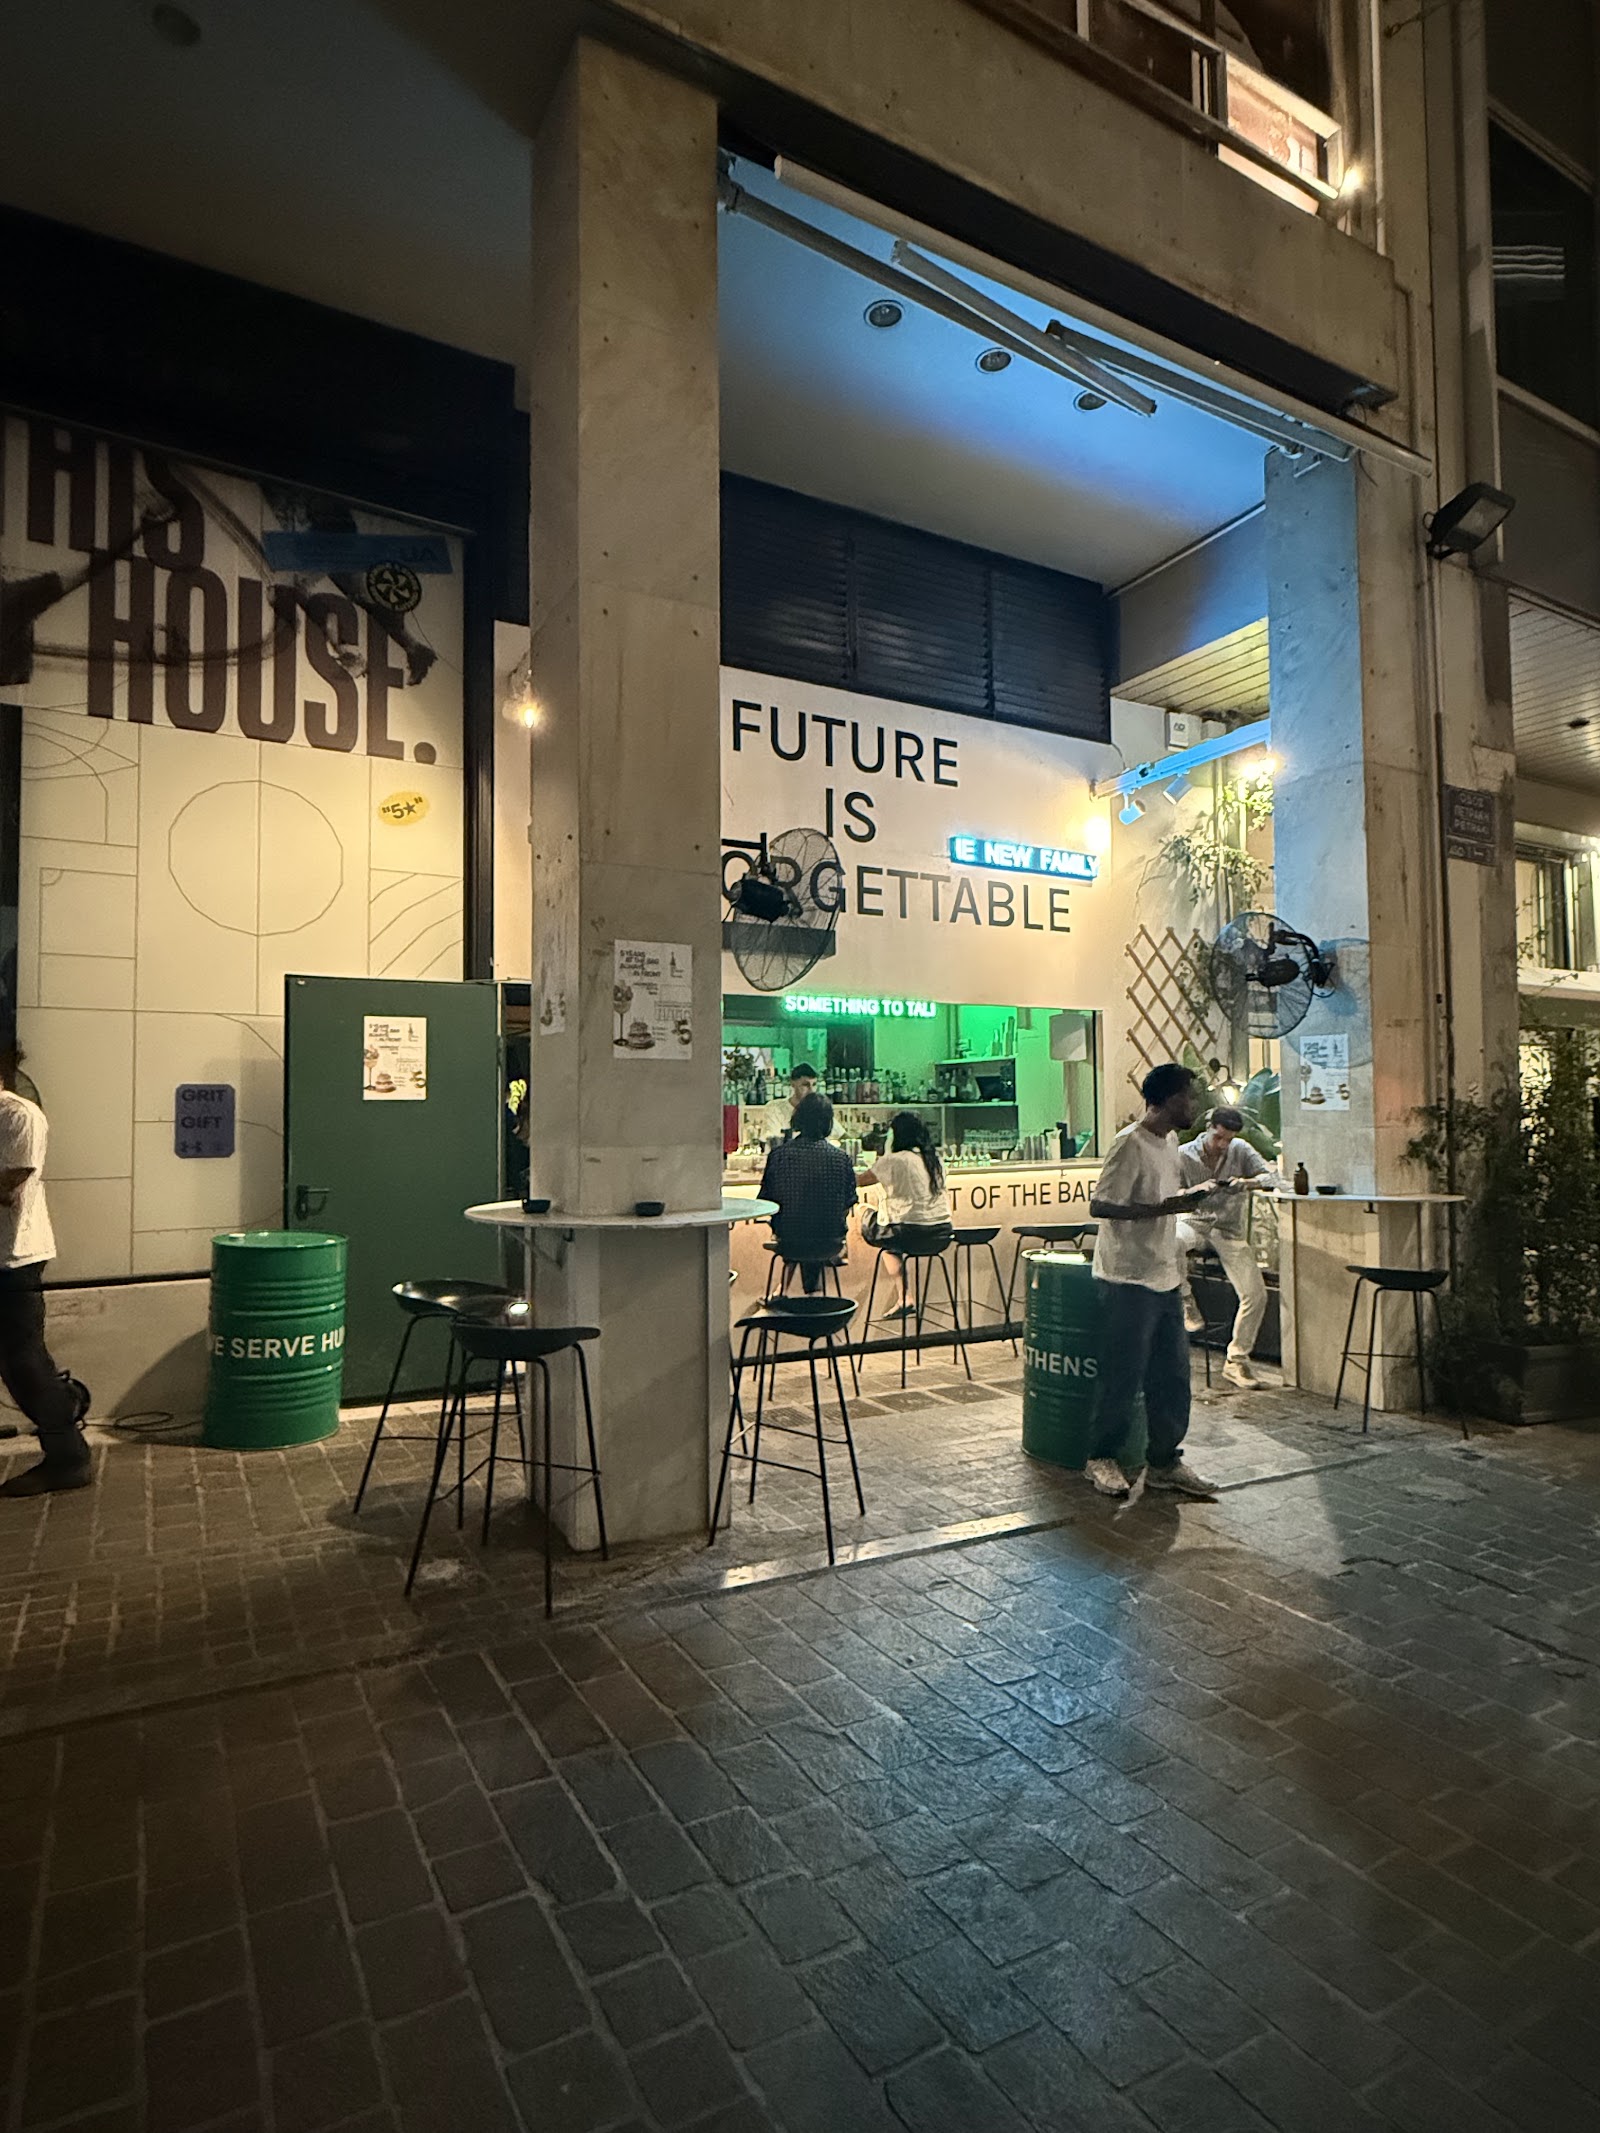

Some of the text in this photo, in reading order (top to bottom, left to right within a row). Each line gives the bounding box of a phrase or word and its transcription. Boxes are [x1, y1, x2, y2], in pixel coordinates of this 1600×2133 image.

[0, 412, 205, 572] HIS
[88, 546, 437, 765] HOUSE.
[731, 699, 959, 788] FUTURE
[825, 788, 877, 843] IS
[983, 841, 1033, 869] NEW
[1039, 847, 1100, 878] FAMILY
[784, 995, 880, 1015] SOMETHING
[881, 999, 904, 1017] TO
[181, 1088, 226, 1102] GRIT
[181, 1116, 223, 1129] GIFT
[971, 1185, 1001, 1210] OF
[1008, 1183, 1052, 1207] THE
[230, 1335, 315, 1359] SERVE
[1024, 1344, 1098, 1378] THENS
